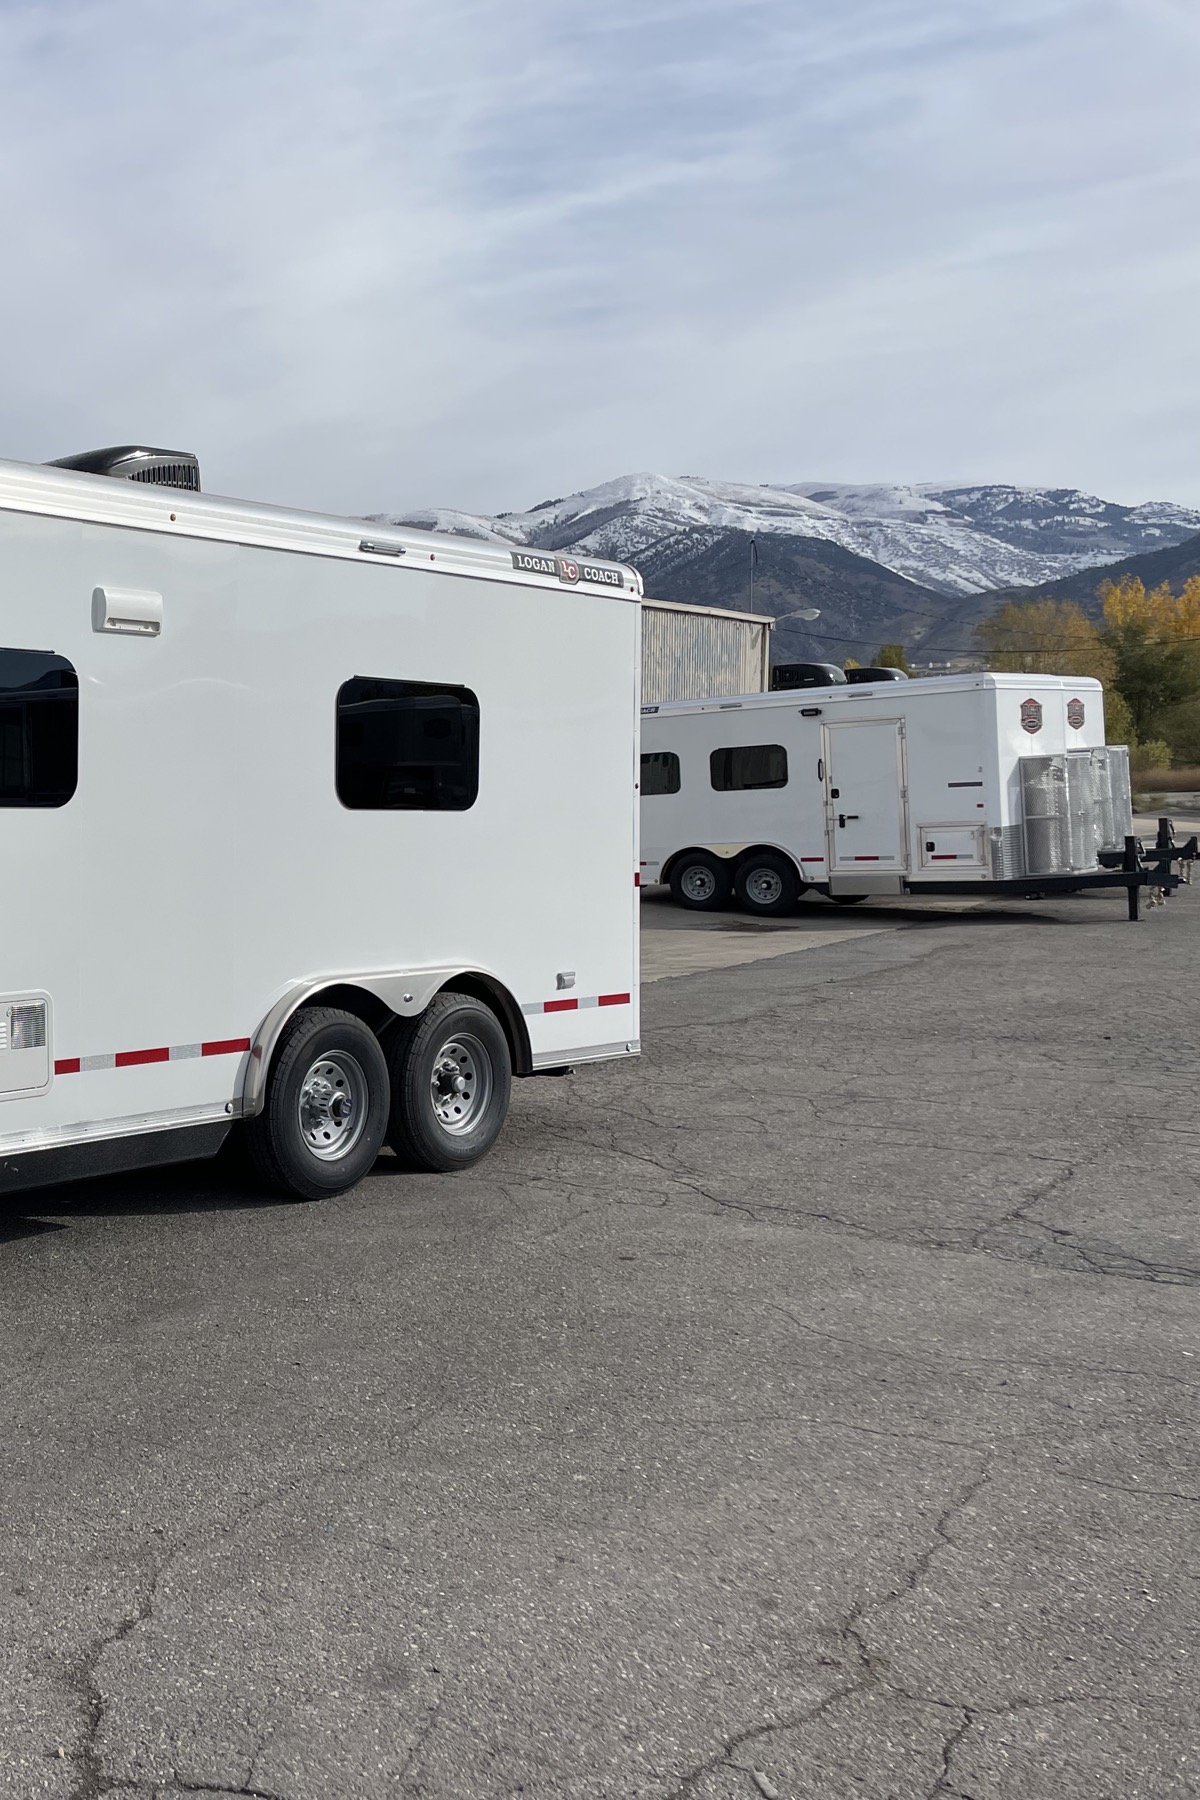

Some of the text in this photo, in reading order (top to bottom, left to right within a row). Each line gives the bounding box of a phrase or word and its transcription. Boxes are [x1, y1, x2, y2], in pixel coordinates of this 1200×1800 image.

[517, 555, 619, 584] LOGAN LC COACH
